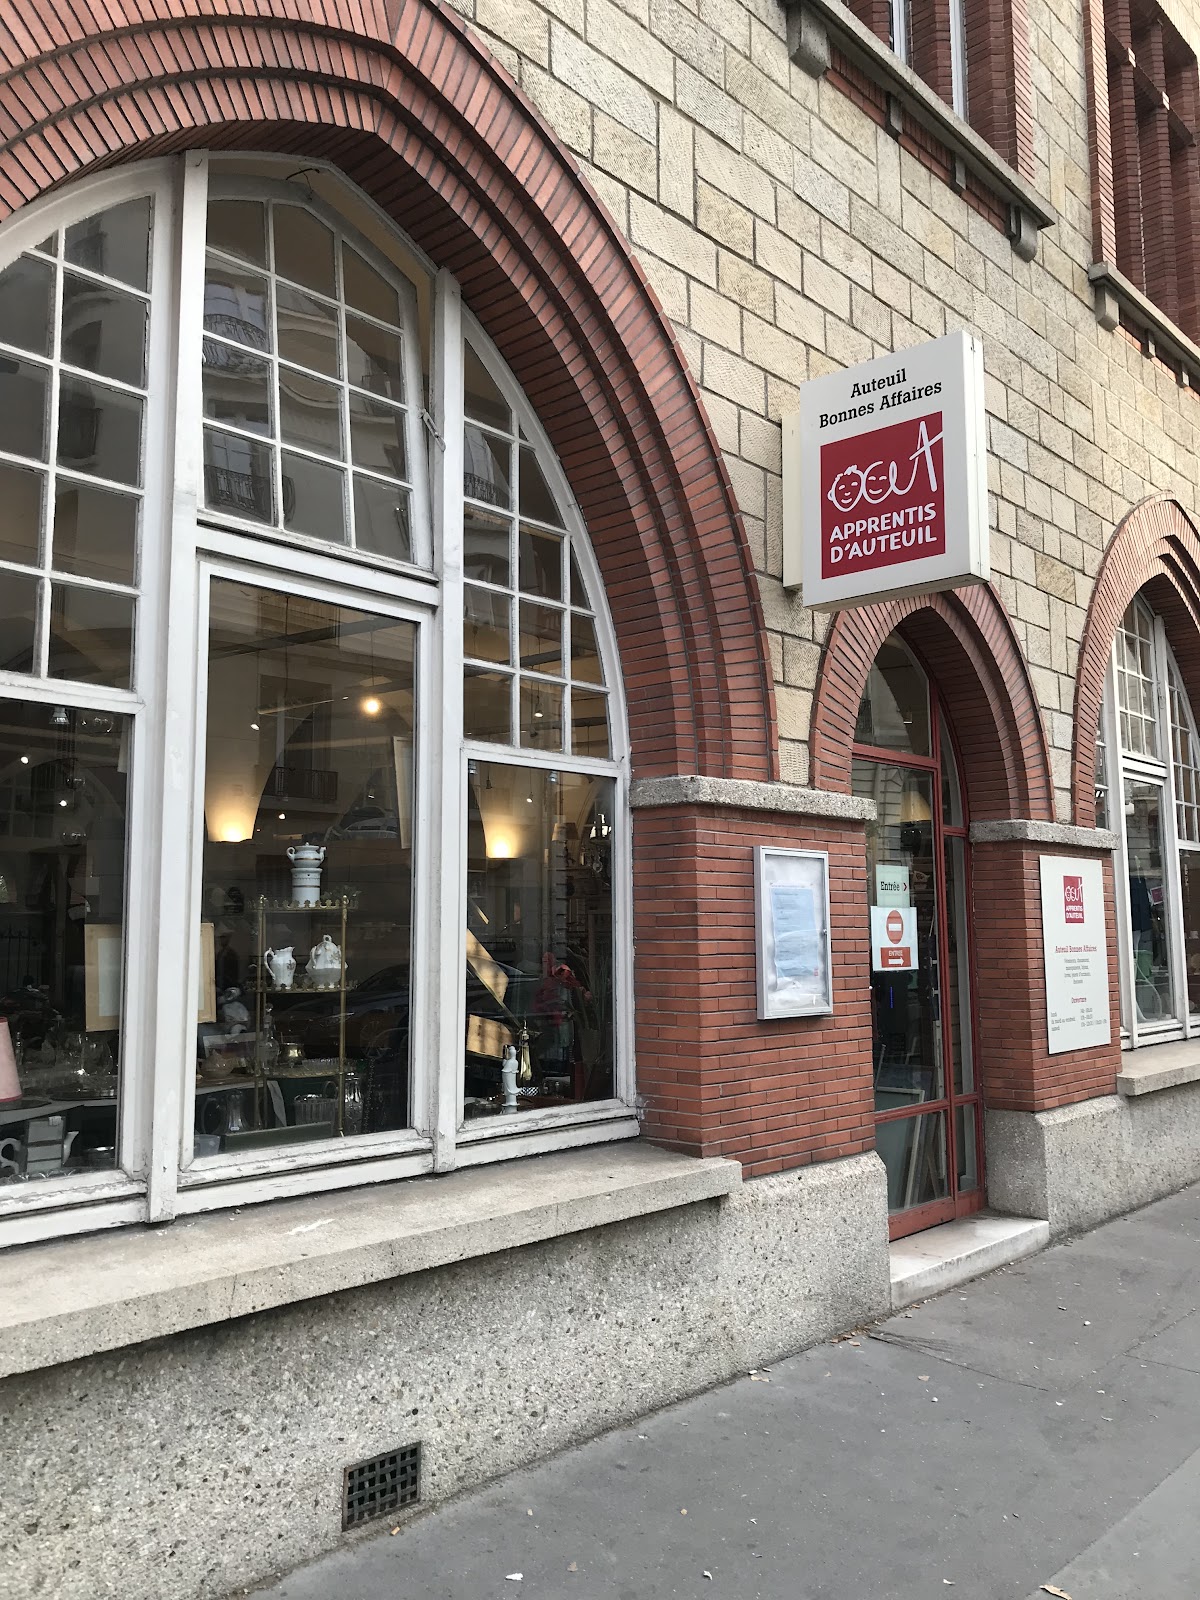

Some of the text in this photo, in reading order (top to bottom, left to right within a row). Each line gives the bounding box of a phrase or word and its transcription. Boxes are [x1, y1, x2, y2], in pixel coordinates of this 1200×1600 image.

[850, 368, 907, 398] Auteuil
[819, 381, 942, 428] Bonnes Affaires
[829, 502, 937, 543] APPRENTIS
[830, 525, 937, 564] D'AUTEUIL
[880, 881, 900, 891] Entrée
[1069, 945, 1082, 953] Bonnes
